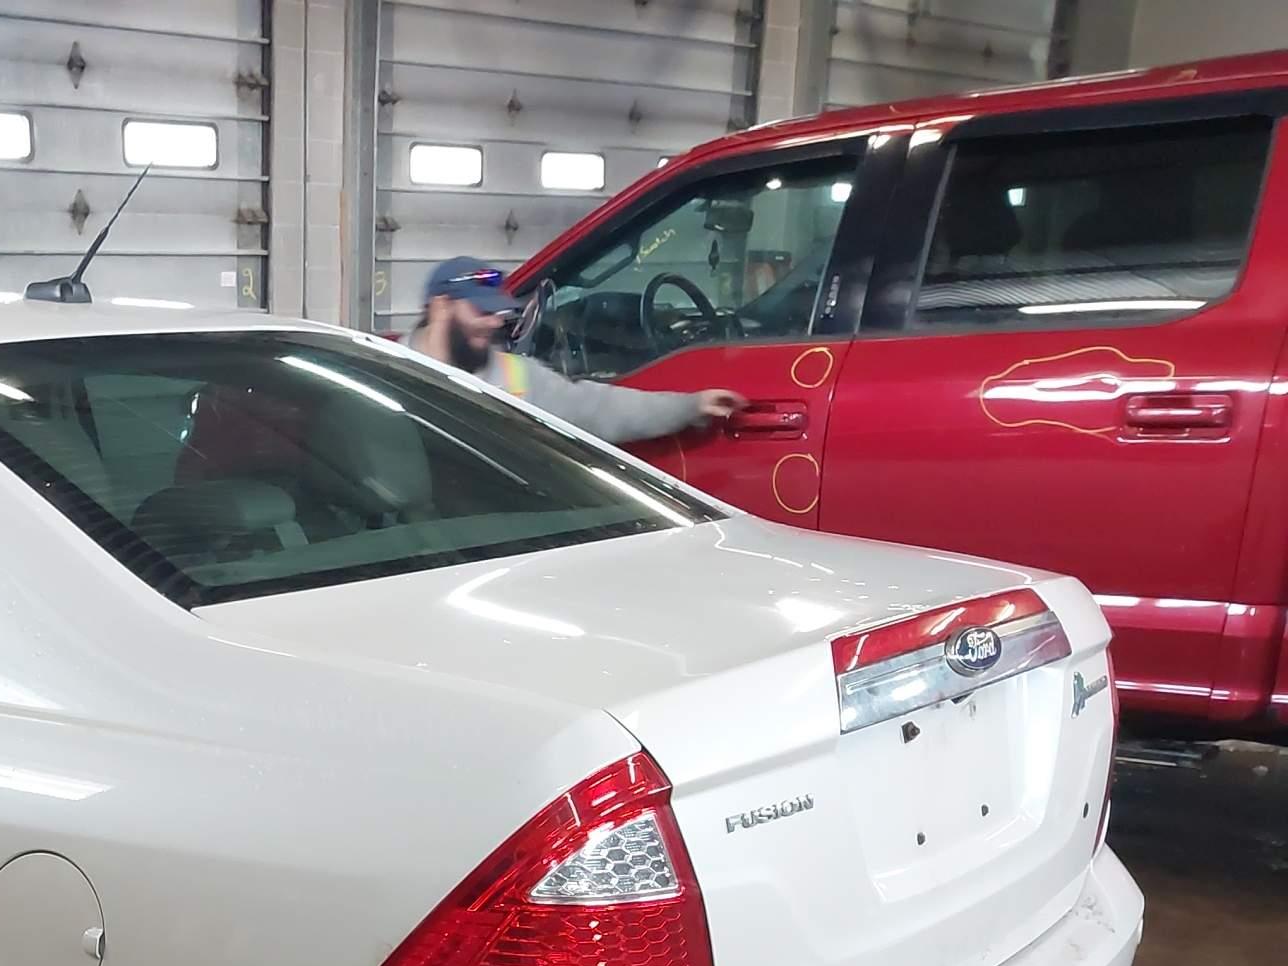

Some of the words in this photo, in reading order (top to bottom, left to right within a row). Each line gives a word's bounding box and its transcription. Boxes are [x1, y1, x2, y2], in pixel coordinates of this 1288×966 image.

[242, 267, 257, 300] 2
[955, 630, 997, 663] Ford
[725, 793, 815, 834] FUSION
